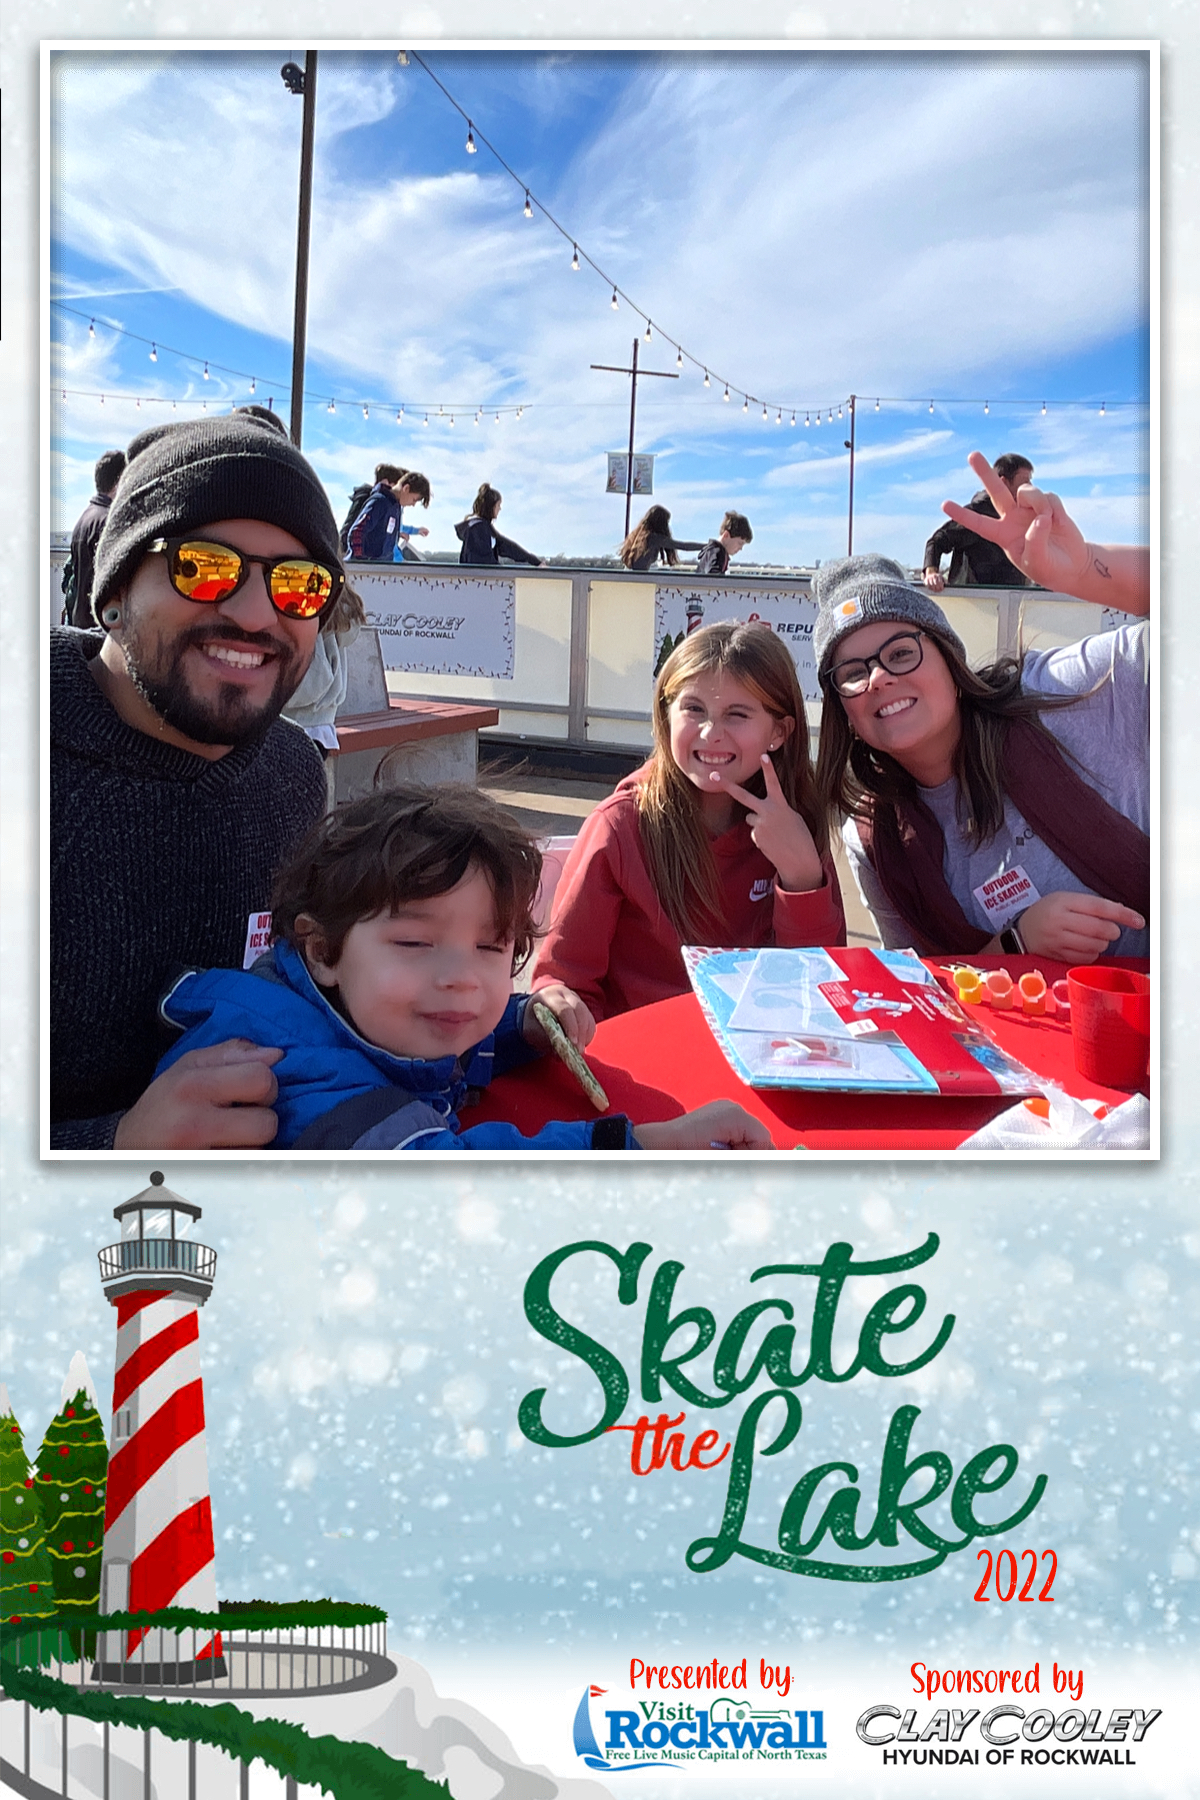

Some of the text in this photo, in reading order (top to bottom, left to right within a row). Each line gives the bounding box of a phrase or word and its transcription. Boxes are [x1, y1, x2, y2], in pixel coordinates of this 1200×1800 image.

[365, 611, 465, 631] CLAY COOLEY
[378, 628, 402, 636] UNDAI
[415, 630, 455, 639] ROCKWALL
[983, 870, 1019, 895] OUTDOOR
[984, 896, 999, 910] ICE
[997, 878, 1031, 903] SKATING
[250, 933, 263, 948] ICE
